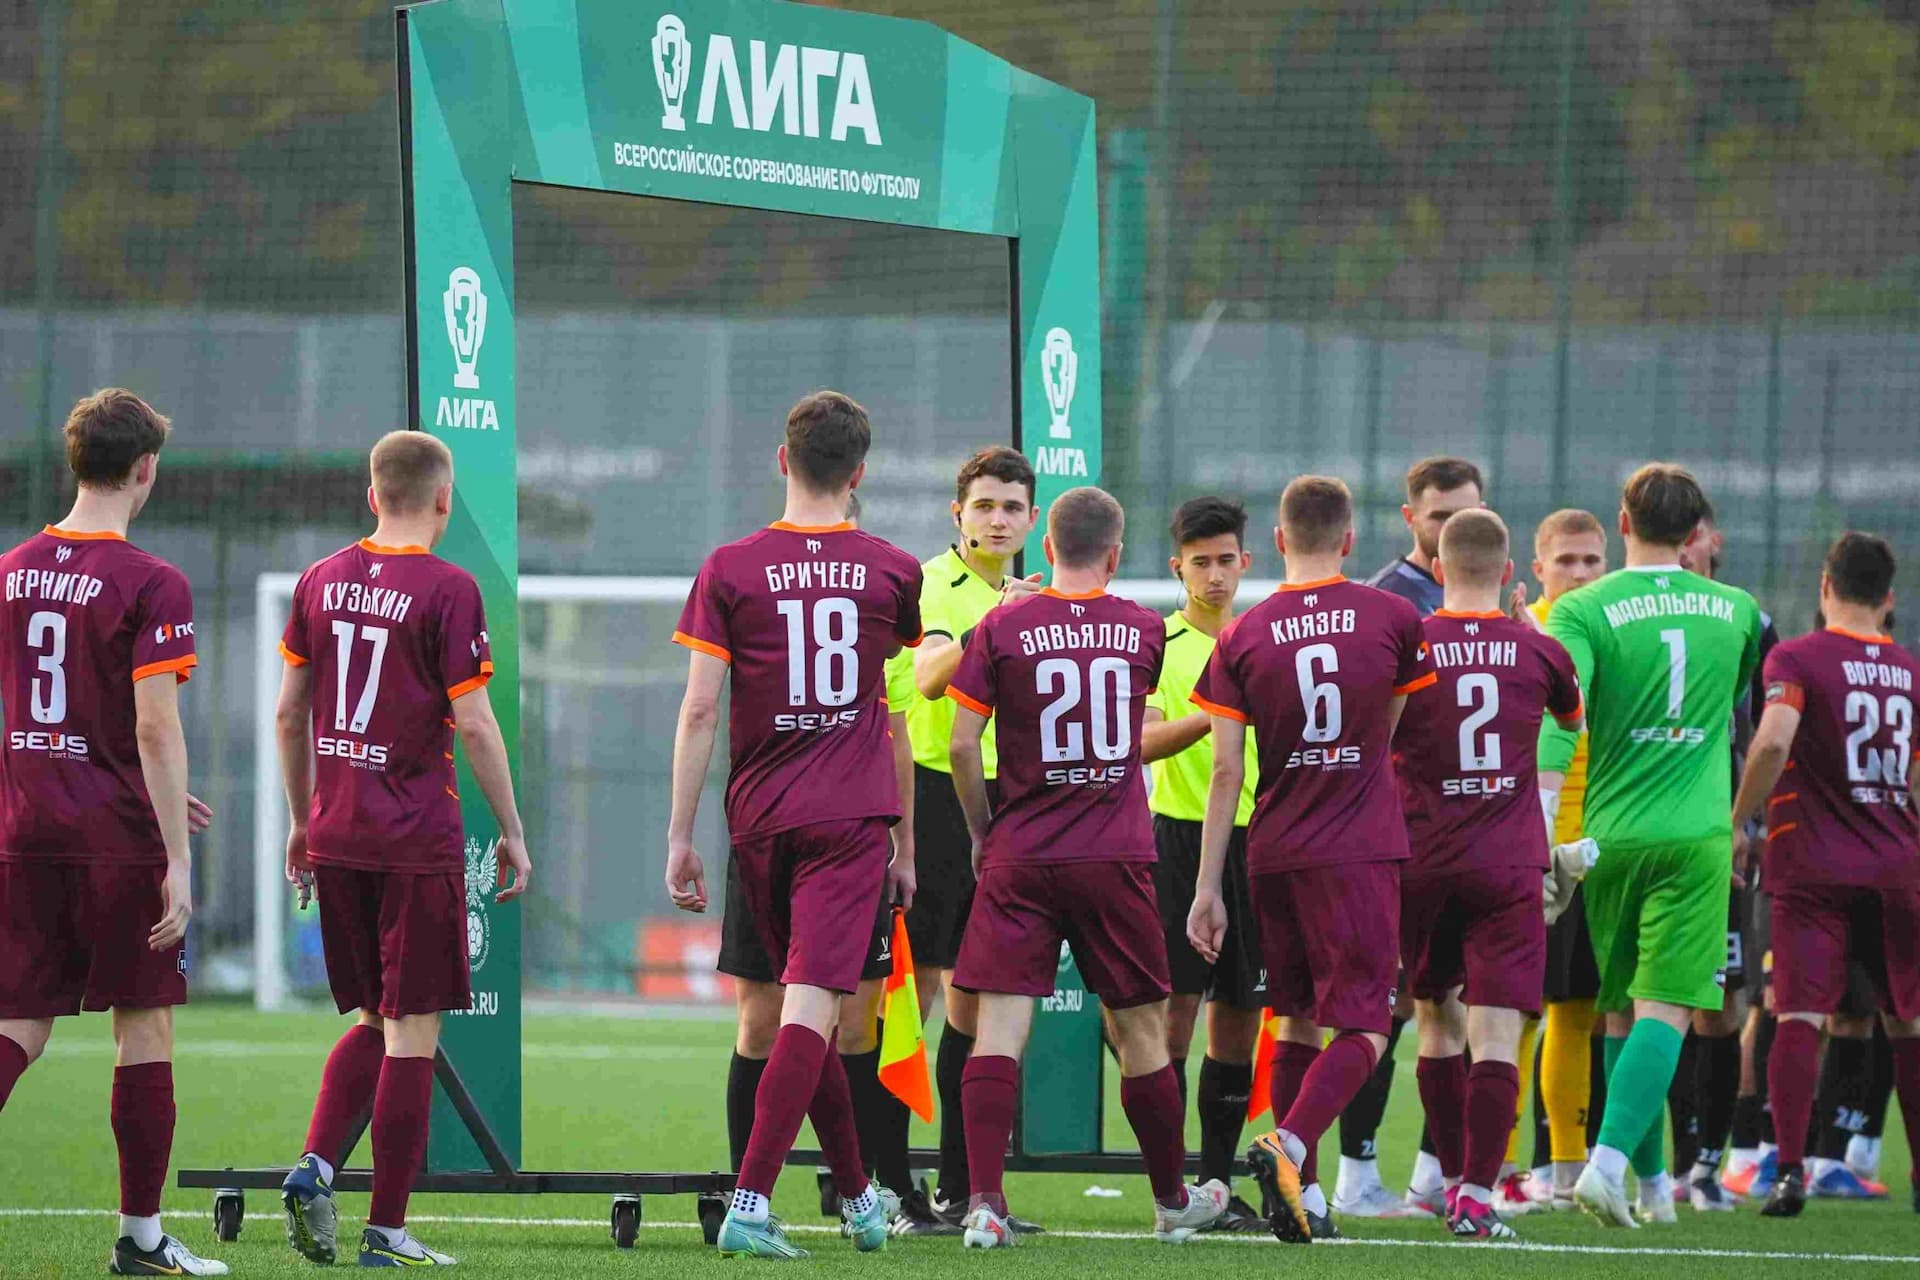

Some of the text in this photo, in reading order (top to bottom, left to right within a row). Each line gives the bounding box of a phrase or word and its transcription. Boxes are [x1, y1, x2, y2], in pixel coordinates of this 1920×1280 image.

[696, 35, 882, 146] ЛИГА
[614, 142, 921, 200] ВСЕРОССИЙСКОЕ СОРЕВНОВАНИЕ ПО ФУТБОЛУ
[436, 396, 500, 431] ЛИГА
[1034, 446, 1088, 477] ЛИГА
[5, 569, 103, 606] ВЕРНИГОР
[765, 561, 867, 593] БРИЧЕЕВ
[323, 582, 413, 623] КУЗЬКИН
[1603, 592, 1735, 628] МАСАЛЬСКИХ
[1019, 623, 1141, 656] ЗАВЬЯЛОВ
[1270, 609, 1356, 646] КНЯЗЕВ
[27, 611, 67, 724] 3
[777, 597, 859, 706] 18
[1432, 641, 1517, 668] ПЛУГИН
[331, 619, 389, 734] 17
[1660, 628, 1686, 719] 1
[1036, 656, 1132, 763] 20
[1295, 643, 1342, 742] 6
[774, 710, 860, 731] SEUS
[1456, 672, 1502, 771] 2
[1630, 727, 1705, 743] SEUS
[1845, 690, 1913, 786] 23
[11, 731, 88, 754] SEUS
[317, 737, 388, 764] SEUS
[1285, 746, 1360, 769] SEUS
[1045, 765, 1126, 786] SEUS
[450, 991, 499, 1016] S.RU
